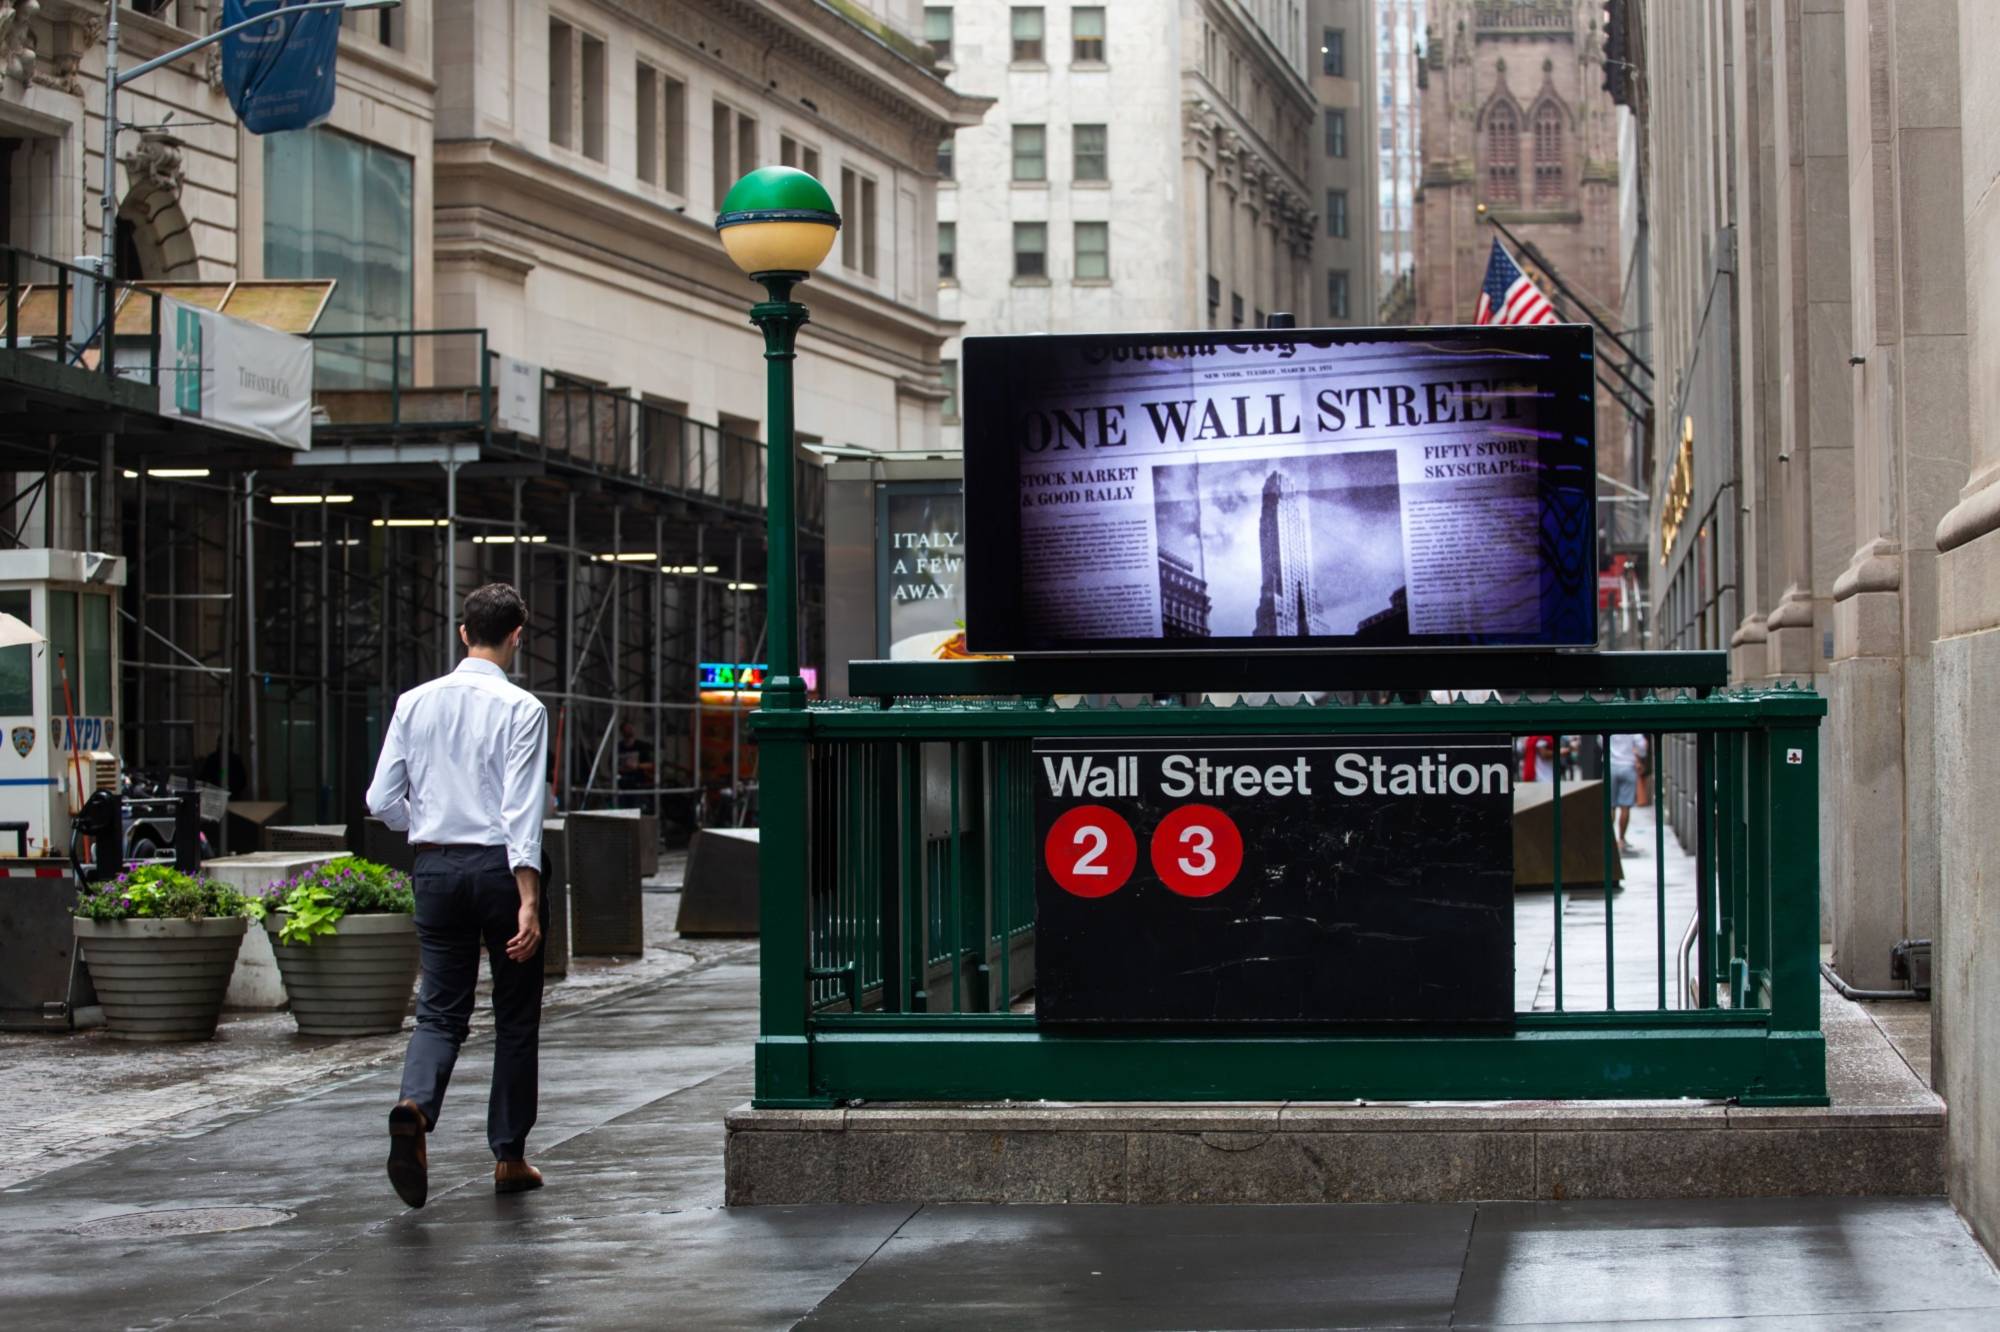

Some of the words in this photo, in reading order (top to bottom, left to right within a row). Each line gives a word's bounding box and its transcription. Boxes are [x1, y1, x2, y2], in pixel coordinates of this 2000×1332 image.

[1020, 404, 1127, 453] ONE
[1141, 394, 1301, 444] WALL
[1316, 378, 1525, 432] STREET
[1424, 445, 1473, 460] FIFTY
[1476, 440, 1529, 456] STORY
[1019, 471, 1067, 490] STOCK
[1071, 467, 1139, 486] MARKET
[1424, 459, 1531, 479] SKYSCRAPER
[1021, 494, 1033, 507] &
[1037, 491, 1081, 506] GOOD
[1085, 486, 1135, 502] RALLY
[894, 532, 959, 549] ITALY
[892, 559, 908, 575] A
[916, 558, 961, 574] FEW
[894, 584, 954, 601] AWAY
[1042, 756, 1138, 797] Wall
[1161, 754, 1311, 797] Street
[1334, 753, 1509, 795] Station
[1072, 825, 1109, 875] 2
[1178, 825, 1216, 876] 3
